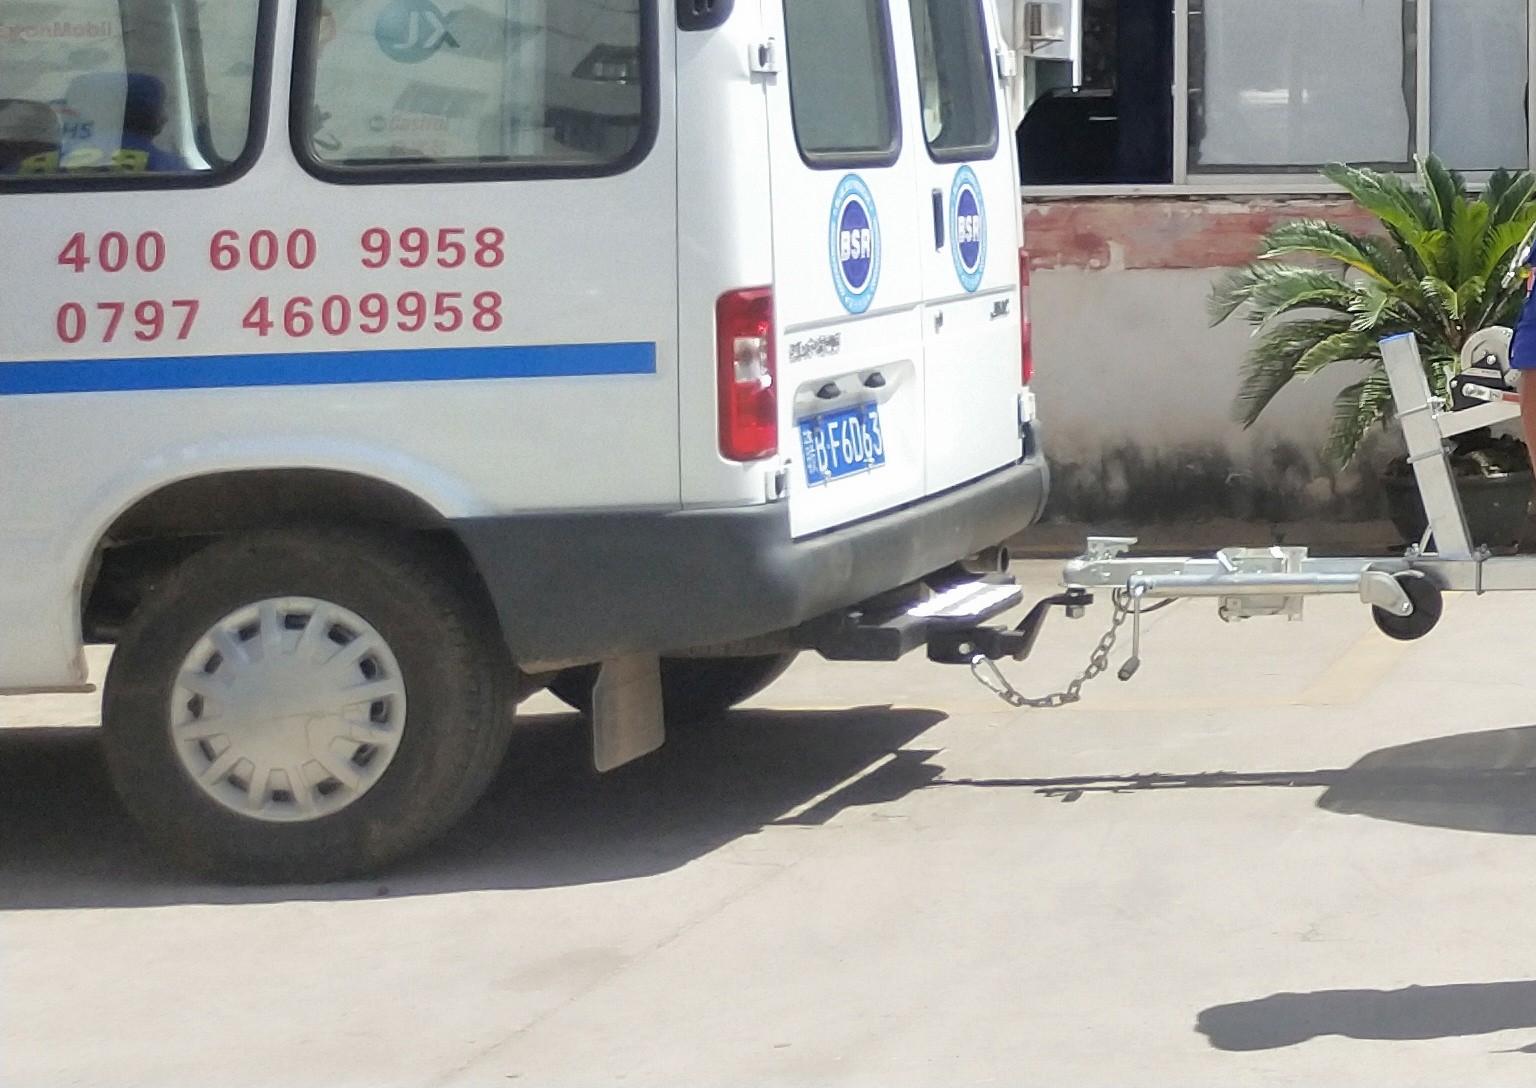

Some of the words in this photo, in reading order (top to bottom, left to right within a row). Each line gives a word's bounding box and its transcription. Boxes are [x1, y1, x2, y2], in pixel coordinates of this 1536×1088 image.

[57, 230, 166, 275] 400
[209, 228, 318, 273] 600
[360, 226, 507, 270] 9958
[839, 227, 871, 262] BSR
[56, 298, 202, 345] 0797
[242, 289, 504, 340] 4609958
